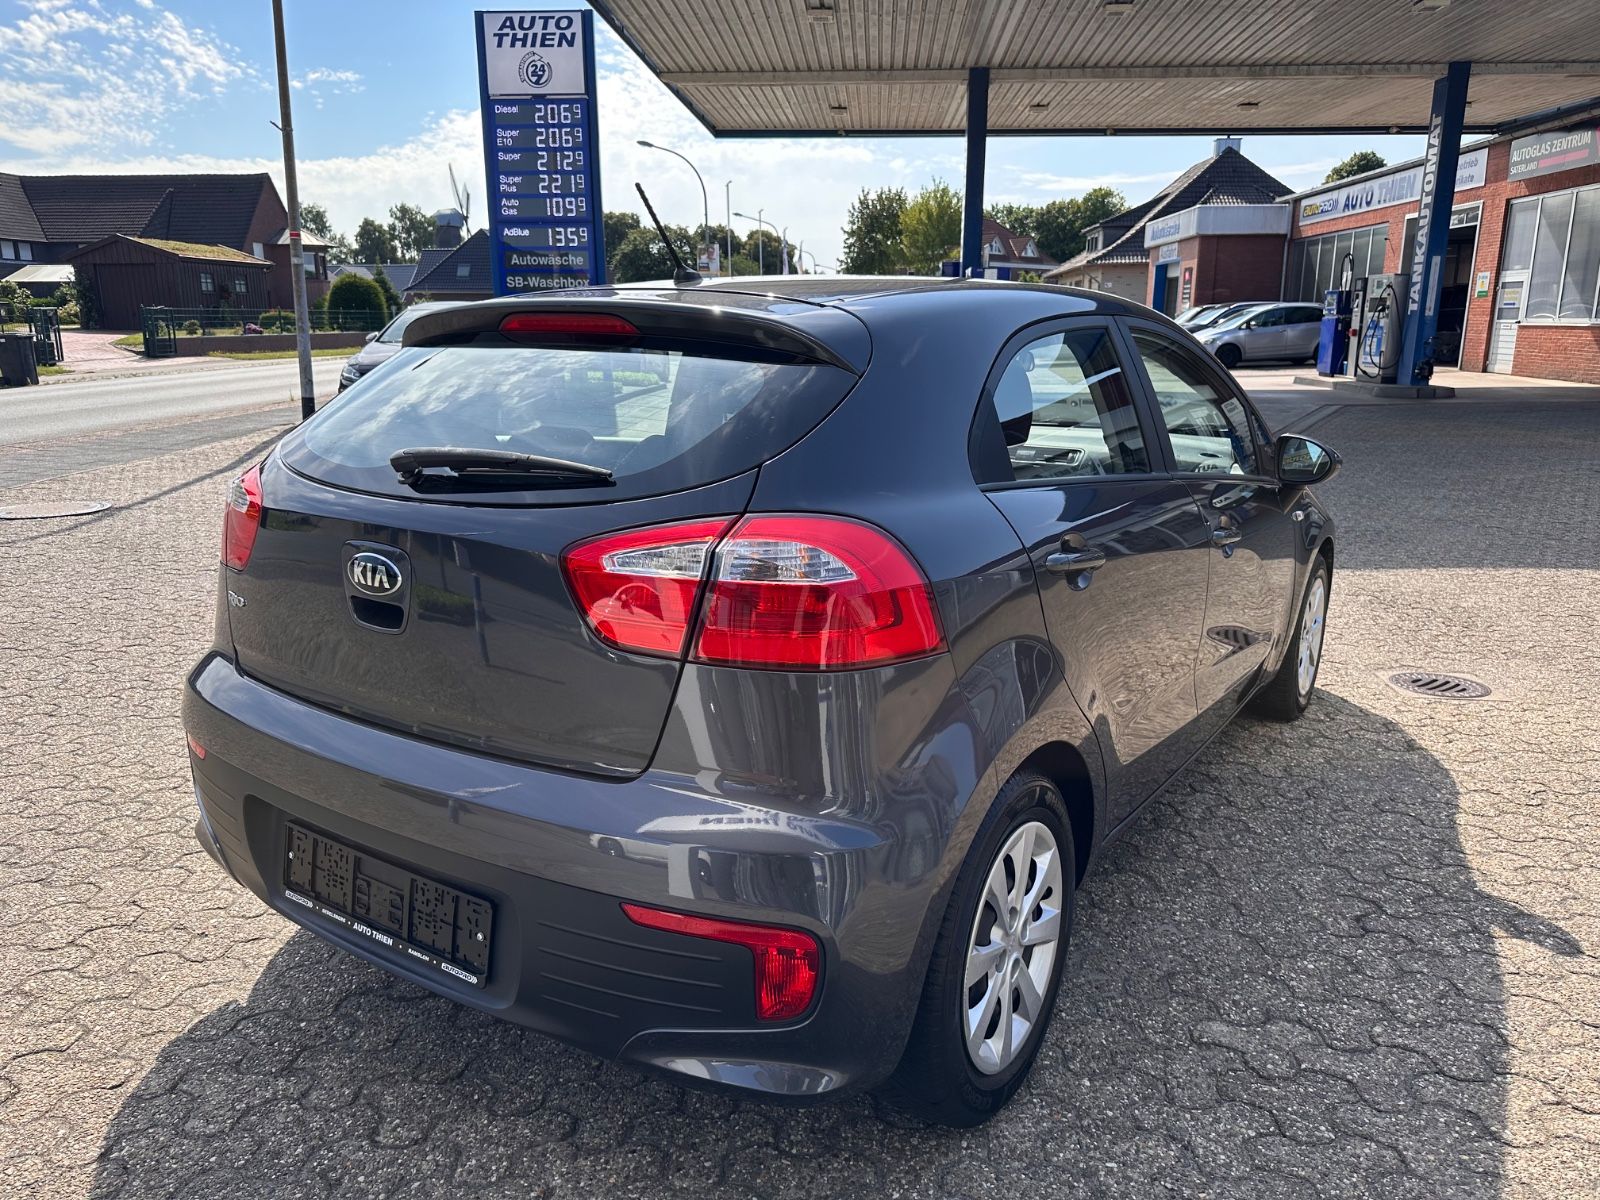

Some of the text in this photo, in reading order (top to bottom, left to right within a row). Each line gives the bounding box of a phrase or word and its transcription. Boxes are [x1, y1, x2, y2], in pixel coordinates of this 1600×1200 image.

[498, 15, 574, 31] AUTO
[493, 32, 576, 48] THIEN
[530, 63, 547, 75] 24
[494, 105, 519, 114] Diesel
[496, 128, 520, 138] Super
[497, 138, 513, 146] E10
[1511, 131, 1592, 163] AUTOGLAS ZENTRUM
[498, 152, 521, 162] Super
[499, 175, 523, 185] Super
[500, 185, 517, 193] Plus
[1342, 186, 1374, 212] AUTO
[1378, 173, 1417, 206] THIEN
[501, 198, 520, 207] Auto
[501, 207, 518, 216] Gas
[1408, 114, 1442, 315] TANKAUTOMAT
[503, 227, 531, 237] AdBlue
[511, 254, 584, 266] Autowäsche
[506, 276, 590, 288] SB-Waschbox
[352, 559, 391, 589] KIA
[353, 922, 394, 947] AUTO THIEN
